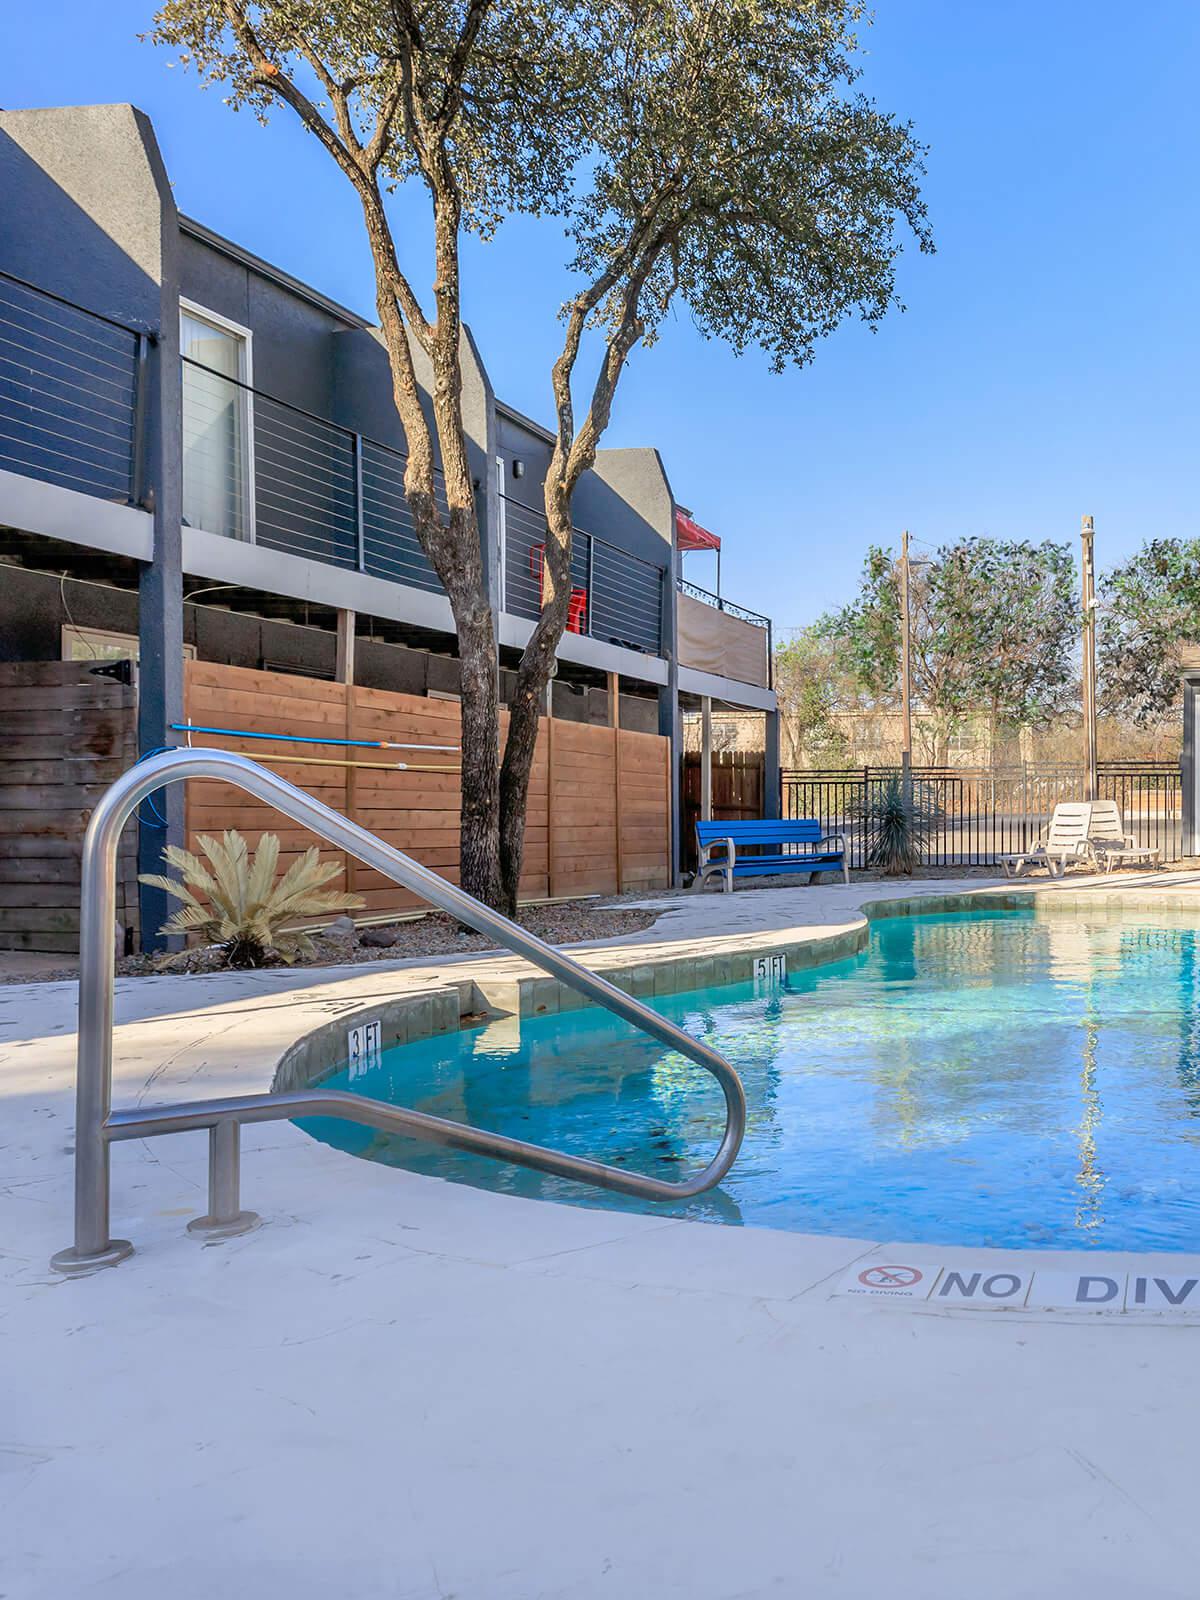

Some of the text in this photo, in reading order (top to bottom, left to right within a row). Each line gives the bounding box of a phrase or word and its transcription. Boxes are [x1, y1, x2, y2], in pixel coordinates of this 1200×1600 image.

[758, 955, 784, 979] 5 FT
[352, 1022, 379, 1058] 3 FT
[938, 1271, 1022, 1298] NO
